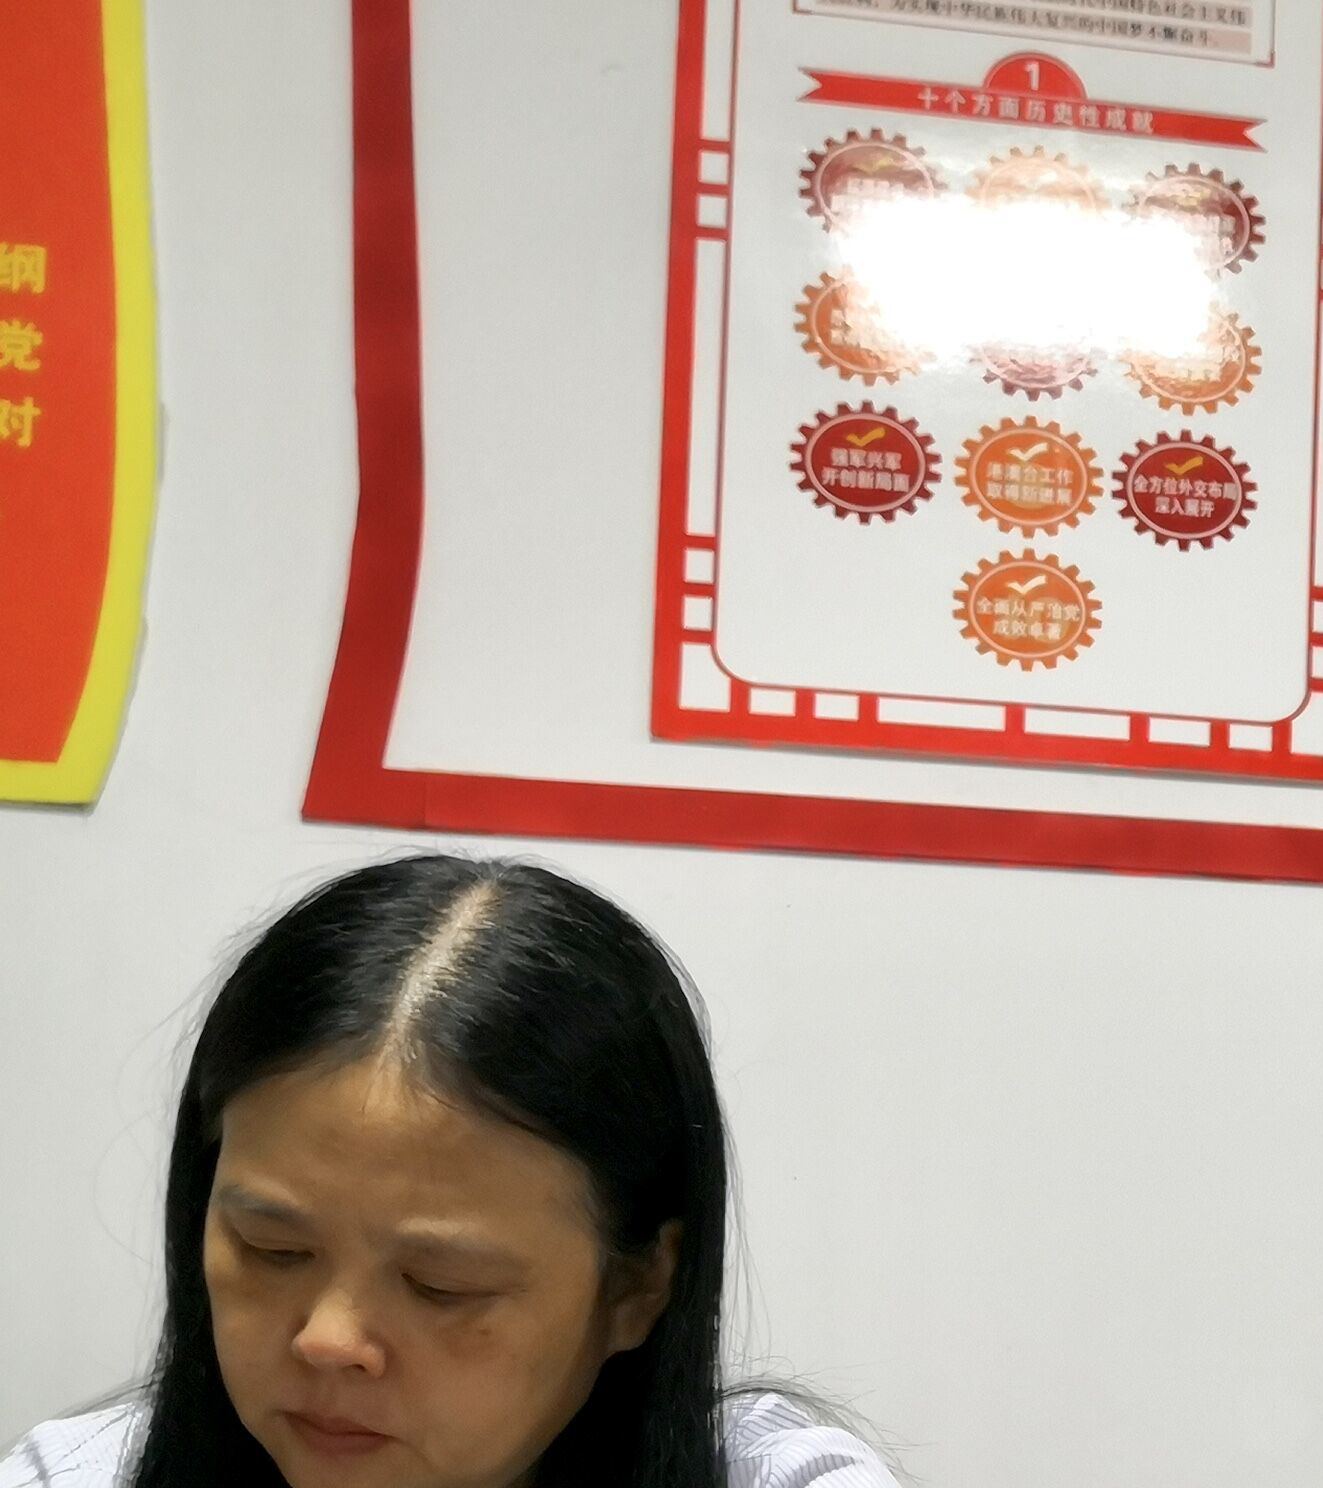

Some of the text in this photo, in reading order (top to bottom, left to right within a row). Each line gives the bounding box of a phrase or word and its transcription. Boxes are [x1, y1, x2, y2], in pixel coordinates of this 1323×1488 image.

[1024, 64, 1041, 90] 1
[917, 87, 1155, 134] 十个方面历史性成就
[0, 320, 43, 371] 党
[821, 467, 909, 493] 开创新局面
[986, 461, 1074, 485] 港澳台工作
[985, 483, 1072, 505] 取得新进展
[1134, 474, 1238, 502] 全方位外交布局
[1154, 497, 1214, 518] 深入展开
[975, 597, 1080, 621] 全面从严治党
[993, 619, 1062, 640] 成效卓著
